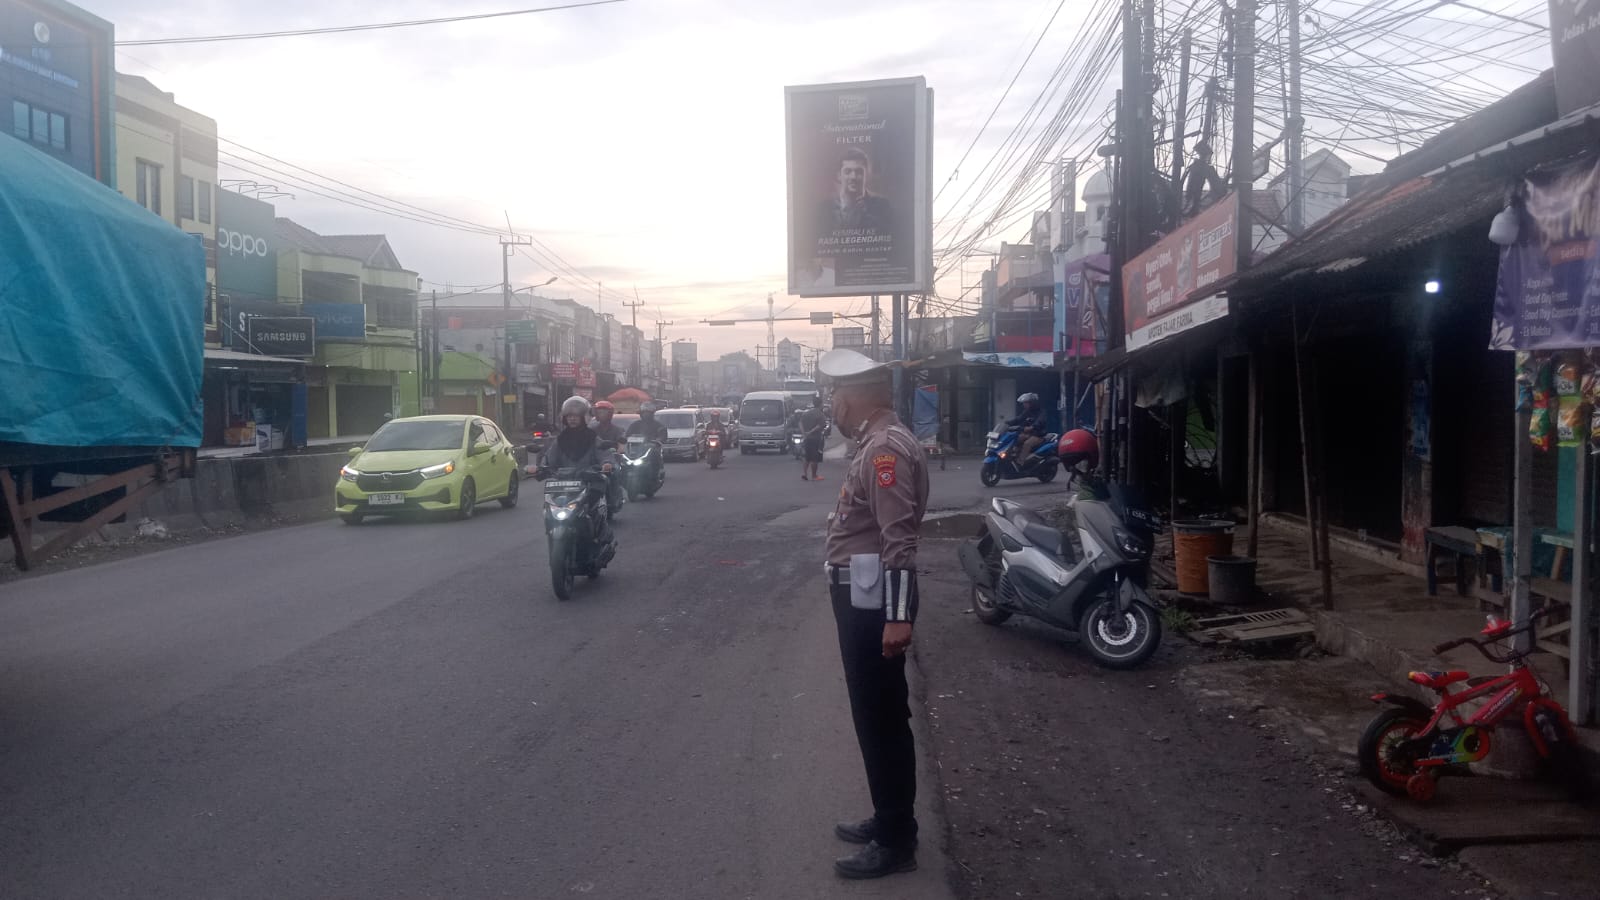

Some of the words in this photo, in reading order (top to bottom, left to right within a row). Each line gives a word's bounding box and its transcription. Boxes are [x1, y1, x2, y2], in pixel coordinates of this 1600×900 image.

[820, 120, 886, 134] International
[836, 135, 872, 145] FILTER
[218, 227, 267, 259] oppo
[818, 237, 839, 245] RASA
[841, 235, 892, 244] LEGENDARIS
[257, 332, 306, 342] SAMSUNG
